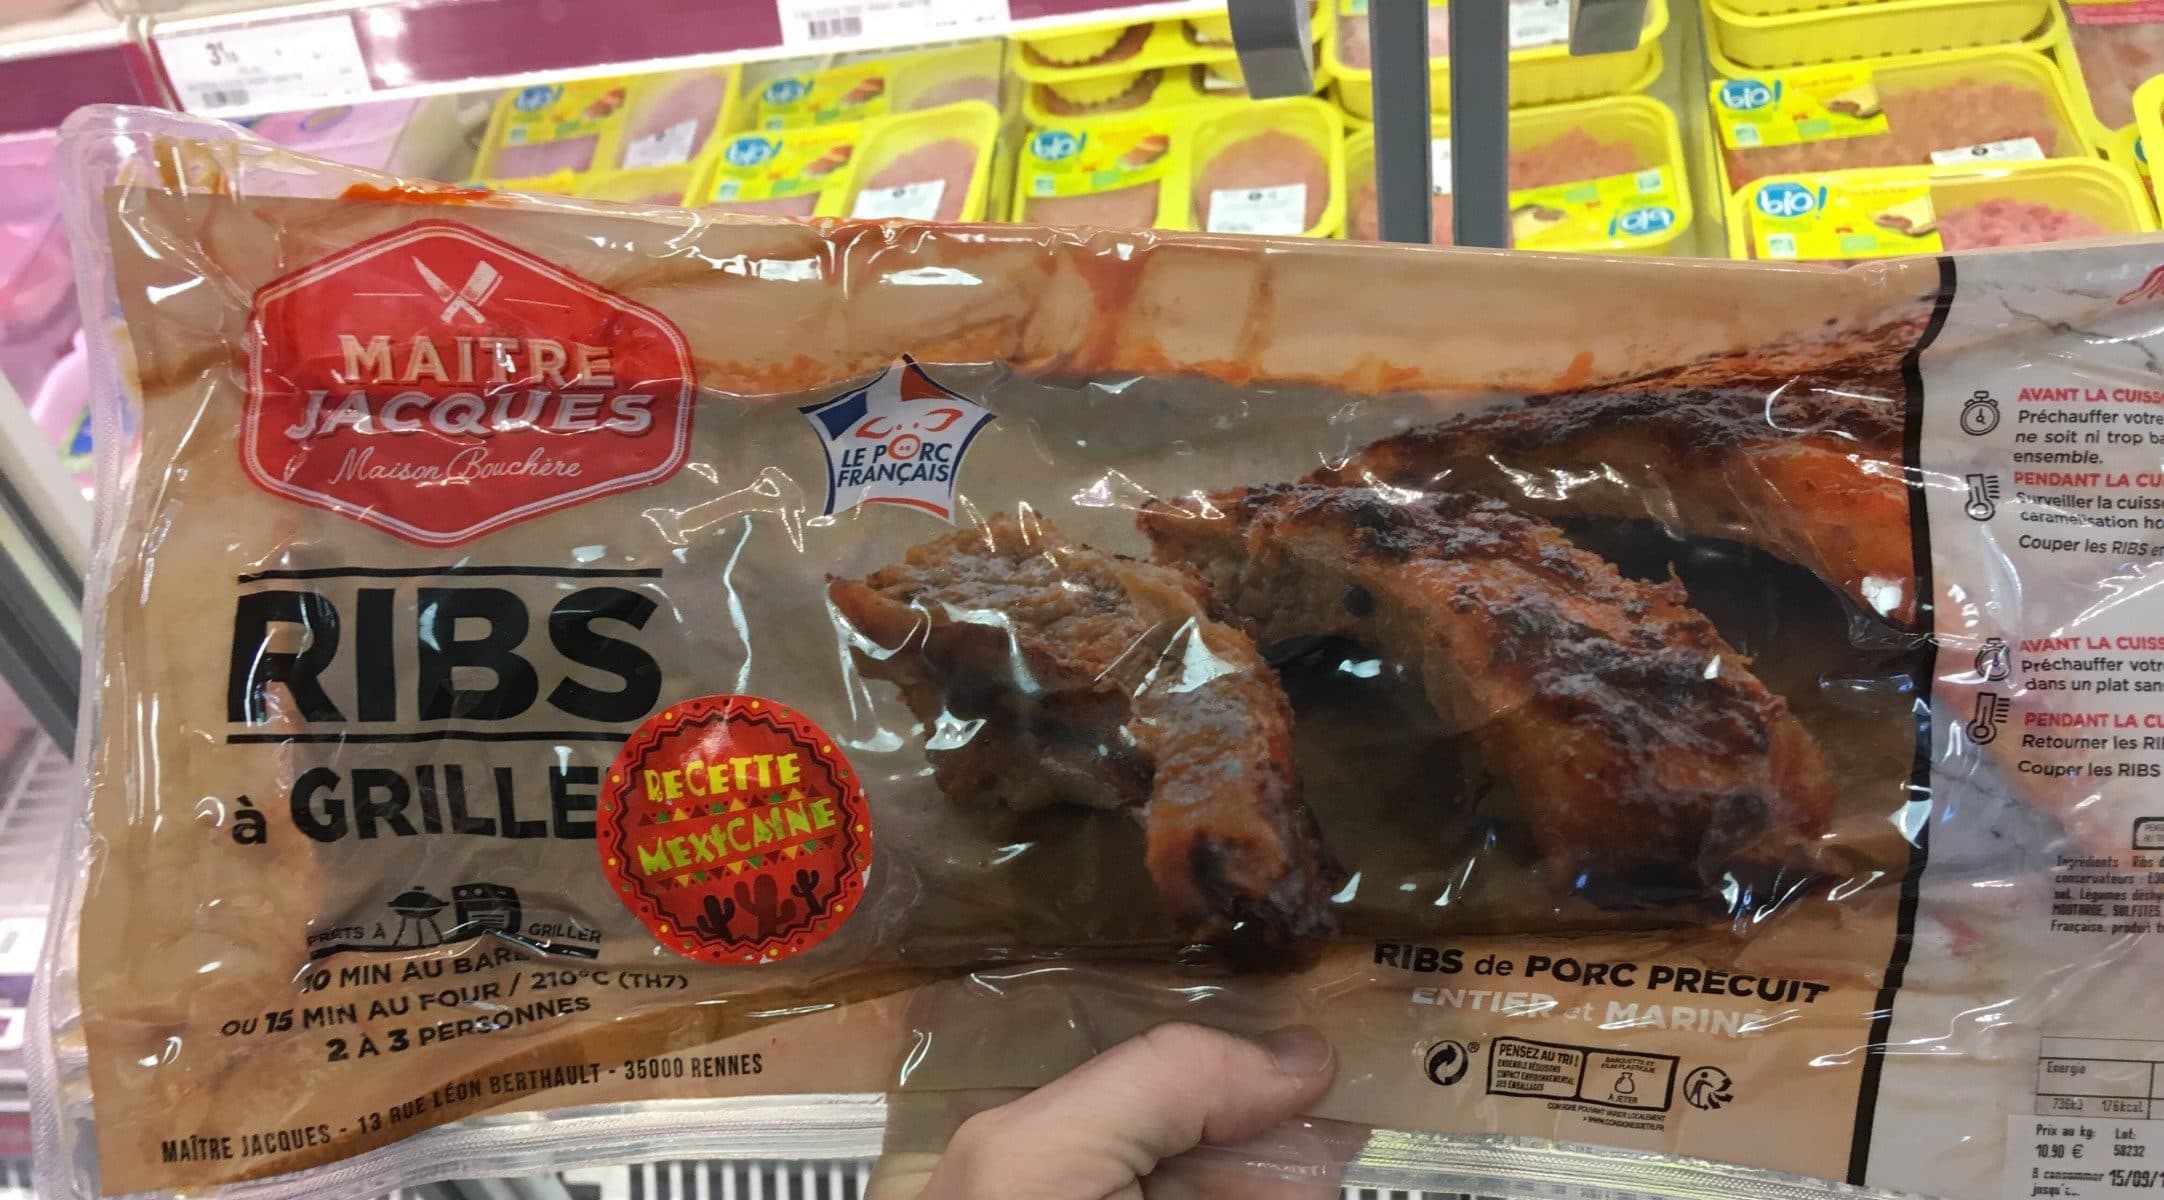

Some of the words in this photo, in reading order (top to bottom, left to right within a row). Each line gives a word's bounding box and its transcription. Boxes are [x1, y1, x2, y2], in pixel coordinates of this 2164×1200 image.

[1757, 185, 1828, 220] bio!
[338, 335, 616, 388] MAITRE
[2018, 388, 2079, 402] AVANT
[2084, 388, 2108, 402] LA
[284, 388, 654, 440] JACQUES
[2018, 408, 2119, 425] Préchauffer
[2015, 432, 2037, 444] ne
[2045, 430, 2077, 444] soit
[2085, 430, 2100, 444] ni
[2107, 430, 2143, 446] trop
[842, 447, 867, 469] LE
[873, 434, 953, 464] PORC
[2013, 449, 2104, 465] ensemble.
[329, 446, 448, 485] Maison
[448, 446, 583, 482] Bouchère
[837, 464, 952, 488] FRANÇAIS
[2013, 472, 2101, 487] PENDANT
[2105, 473, 2130, 487] LA
[2016, 491, 2092, 509] Surveiller
[2098, 496, 2112, 509] la
[2019, 534, 2080, 552] Couper
[2085, 538, 2107, 553] les
[2112, 540, 2149, 556] RIBS
[227, 587, 662, 723] RIBS
[2019, 637, 2080, 652] AVANT
[2086, 637, 2110, 650] LA
[2021, 657, 2122, 673] Préchauffer
[2025, 678, 2066, 691] dans
[2072, 680, 2091, 691] un
[2096, 678, 2129, 693] plat
[2025, 712, 2108, 728] PENDANT
[2114, 713, 2137, 728] LA
[2022, 733, 2108, 749] Retourner
[2114, 735, 2137, 750] les
[644, 753, 800, 802] RECETTE
[2018, 760, 2083, 778] Couper
[2088, 762, 2112, 776] les
[2118, 763, 2161, 777] RIBS
[231, 796, 268, 845] à
[290, 764, 611, 842] GRILLE
[528, 921, 603, 944] GRILLER
[340, 961, 392, 988] MIN
[402, 955, 443, 981] AU
[1373, 942, 1464, 974] RIBS
[1473, 953, 1514, 978] de
[1525, 954, 1637, 989] PORC
[220, 1015, 258, 1037] OU
[266, 1010, 294, 1034] 15
[303, 1000, 358, 1030] MIN
[368, 993, 411, 1022] AU
[421, 981, 500, 1013] FOUR
[530, 969, 610, 991] 210°C
[618, 970, 690, 991] (TH7)
[1411, 986, 1555, 1020] ENTIER
[1563, 999, 1596, 1023] et
[327, 1037, 350, 1062] 2
[358, 1031, 380, 1058] À
[387, 1027, 411, 1052] 3
[420, 995, 592, 1048] PERSONNES
[1499, 1043, 1539, 1060] PENSEZ
[1541, 1048, 1555, 1062] AU
[1558, 1052, 1573, 1066] TRI
[2047, 1061, 2087, 1076] Energie
[161, 1133, 234, 1163] MAÎTRE
[241, 1123, 331, 1157] JACQUES
[358, 1111, 382, 1134] 13
[390, 1096, 427, 1123] RUE
[433, 1077, 481, 1111] LÉON
[489, 1062, 600, 1095] BERTHAULT
[624, 1057, 684, 1081] 35000
[691, 1053, 764, 1078] RENNES
[2036, 1123, 2057, 1136] Prix
[2062, 1127, 2075, 1137] au
[2072, 1143, 2084, 1158] €
